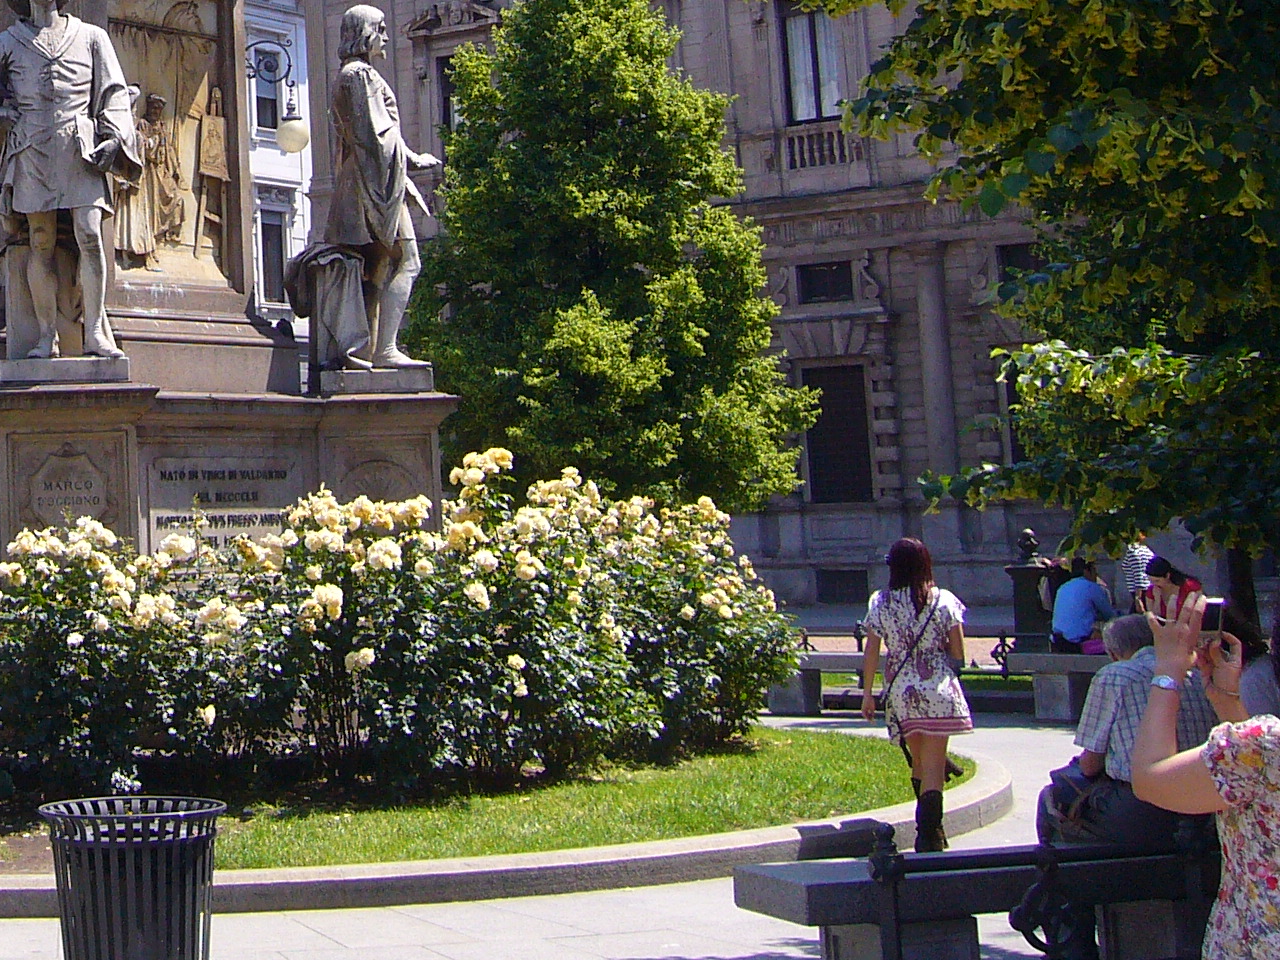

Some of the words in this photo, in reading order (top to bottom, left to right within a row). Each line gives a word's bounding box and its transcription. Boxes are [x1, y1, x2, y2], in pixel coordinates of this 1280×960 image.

[160, 470, 186, 481] NATO
[201, 470, 226, 481] VINCI
[43, 479, 93, 491] MARCO
